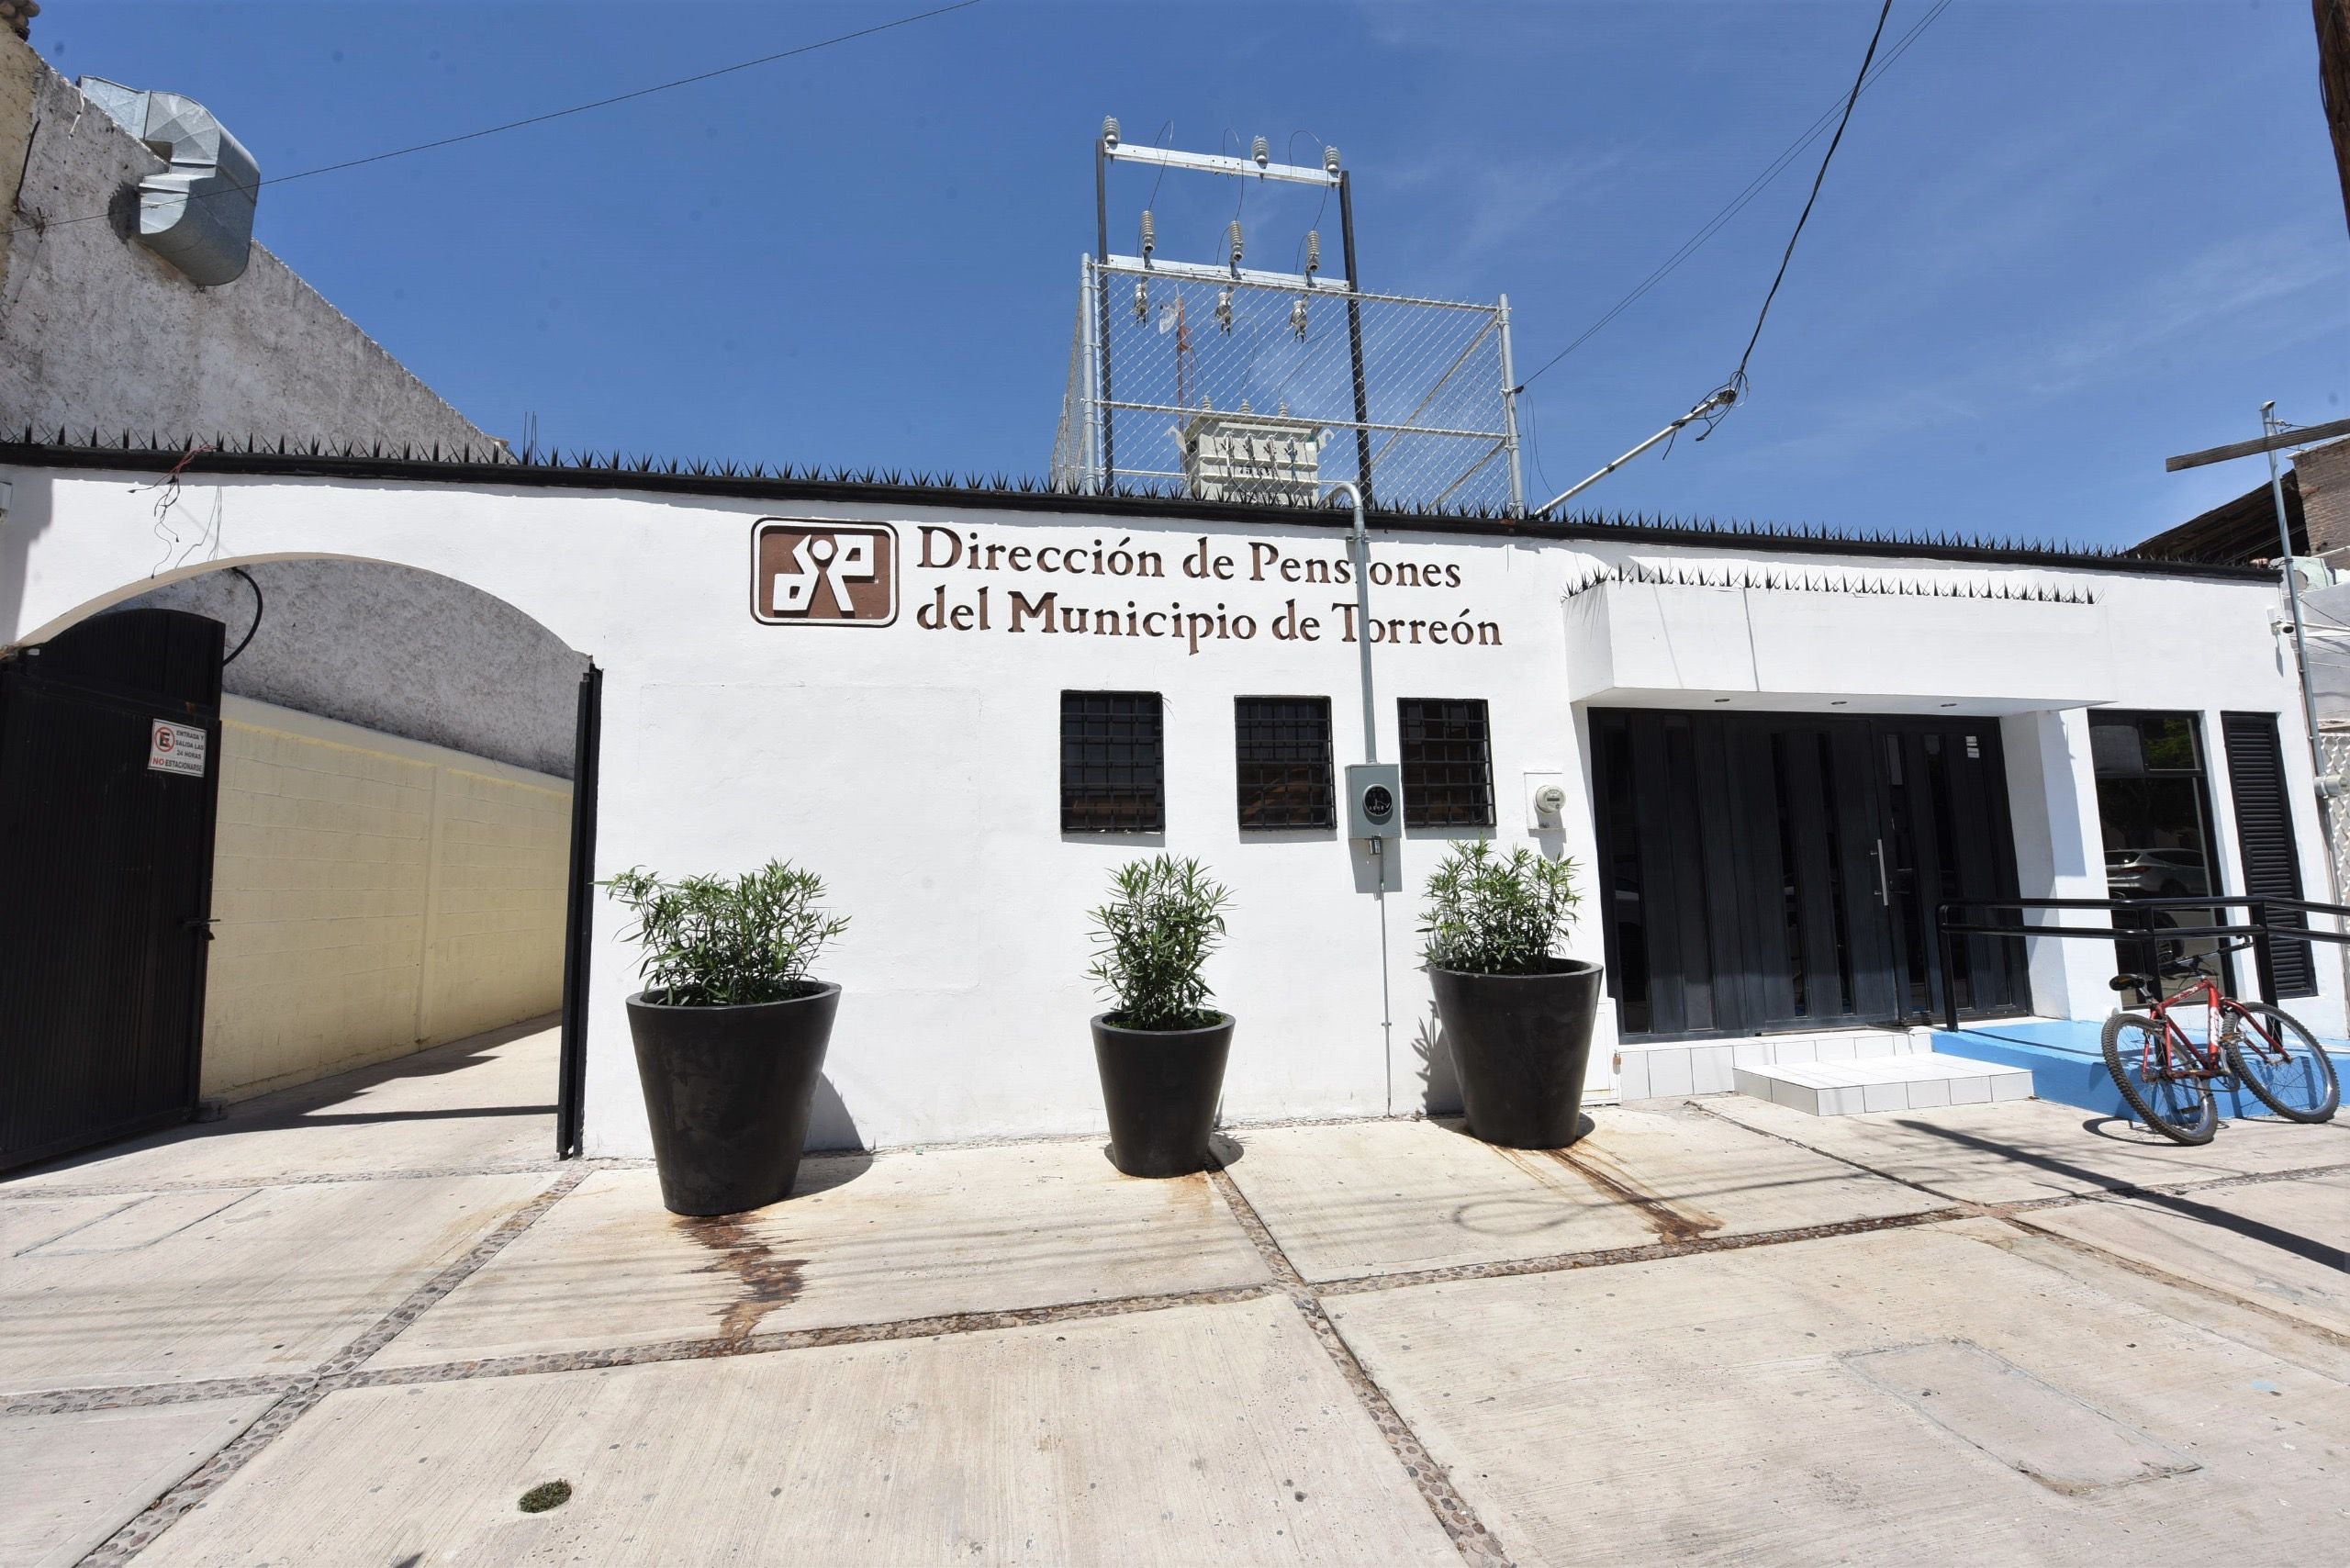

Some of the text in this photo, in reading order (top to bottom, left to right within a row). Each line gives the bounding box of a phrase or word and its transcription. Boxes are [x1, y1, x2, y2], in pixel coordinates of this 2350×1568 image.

[916, 525, 1462, 588] Dirección de Pensones
[916, 584, 1504, 656] del Municipio de Torreón
[176, 730, 200, 740] ENTRADA
[176, 740, 193, 748] SALIDA
